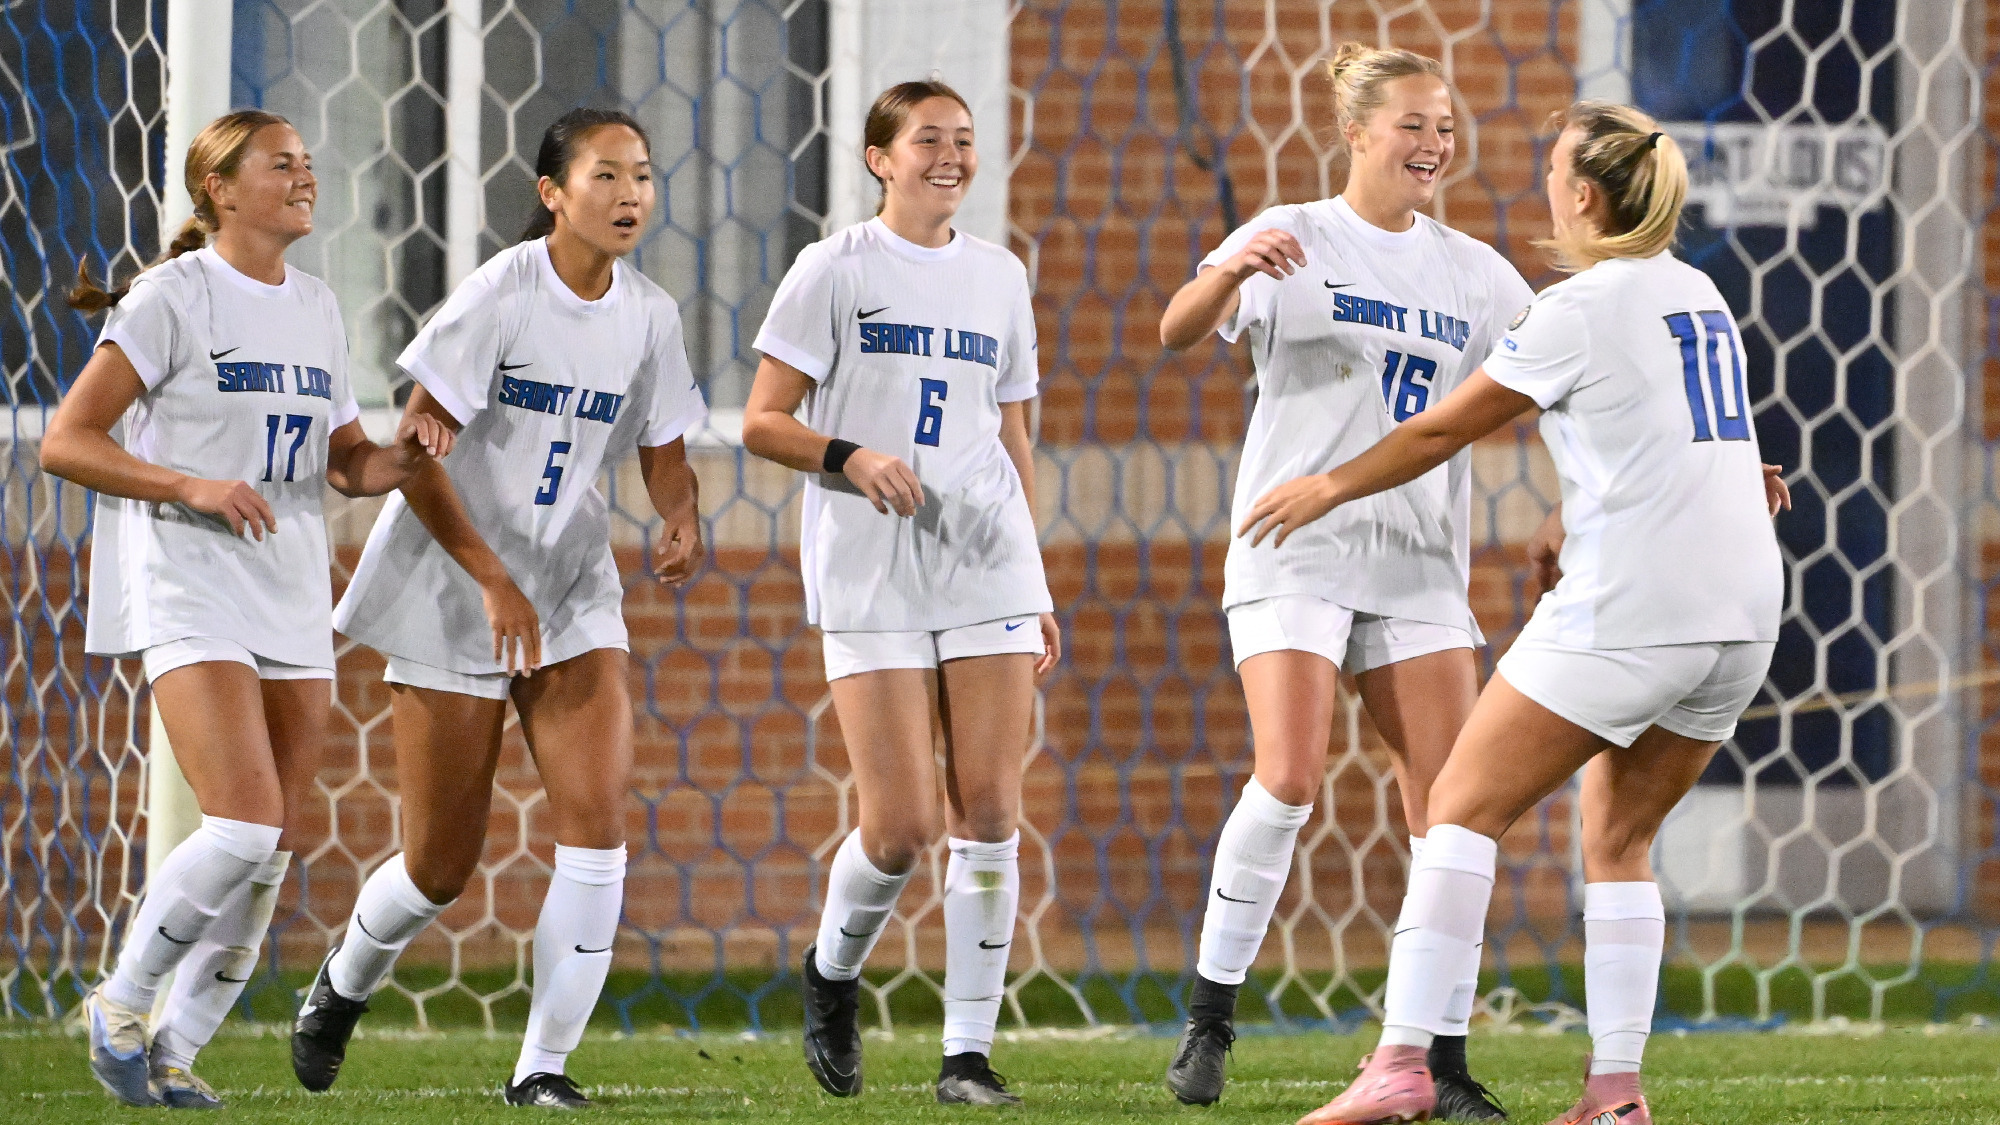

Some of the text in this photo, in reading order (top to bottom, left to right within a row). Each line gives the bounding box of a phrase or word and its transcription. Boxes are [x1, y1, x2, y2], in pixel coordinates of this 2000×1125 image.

[1332, 291, 1408, 333] SAINT
[858, 322, 998, 370] SAINT LOUIS
[1661, 310, 1751, 442] 10
[214, 361, 332, 401] SAINT LOU
[498, 373, 626, 424] SAINT LOU
[914, 377, 948, 447] 6
[1382, 350, 1437, 423] 16
[261, 413, 313, 482] 17
[534, 441, 572, 506] 5
